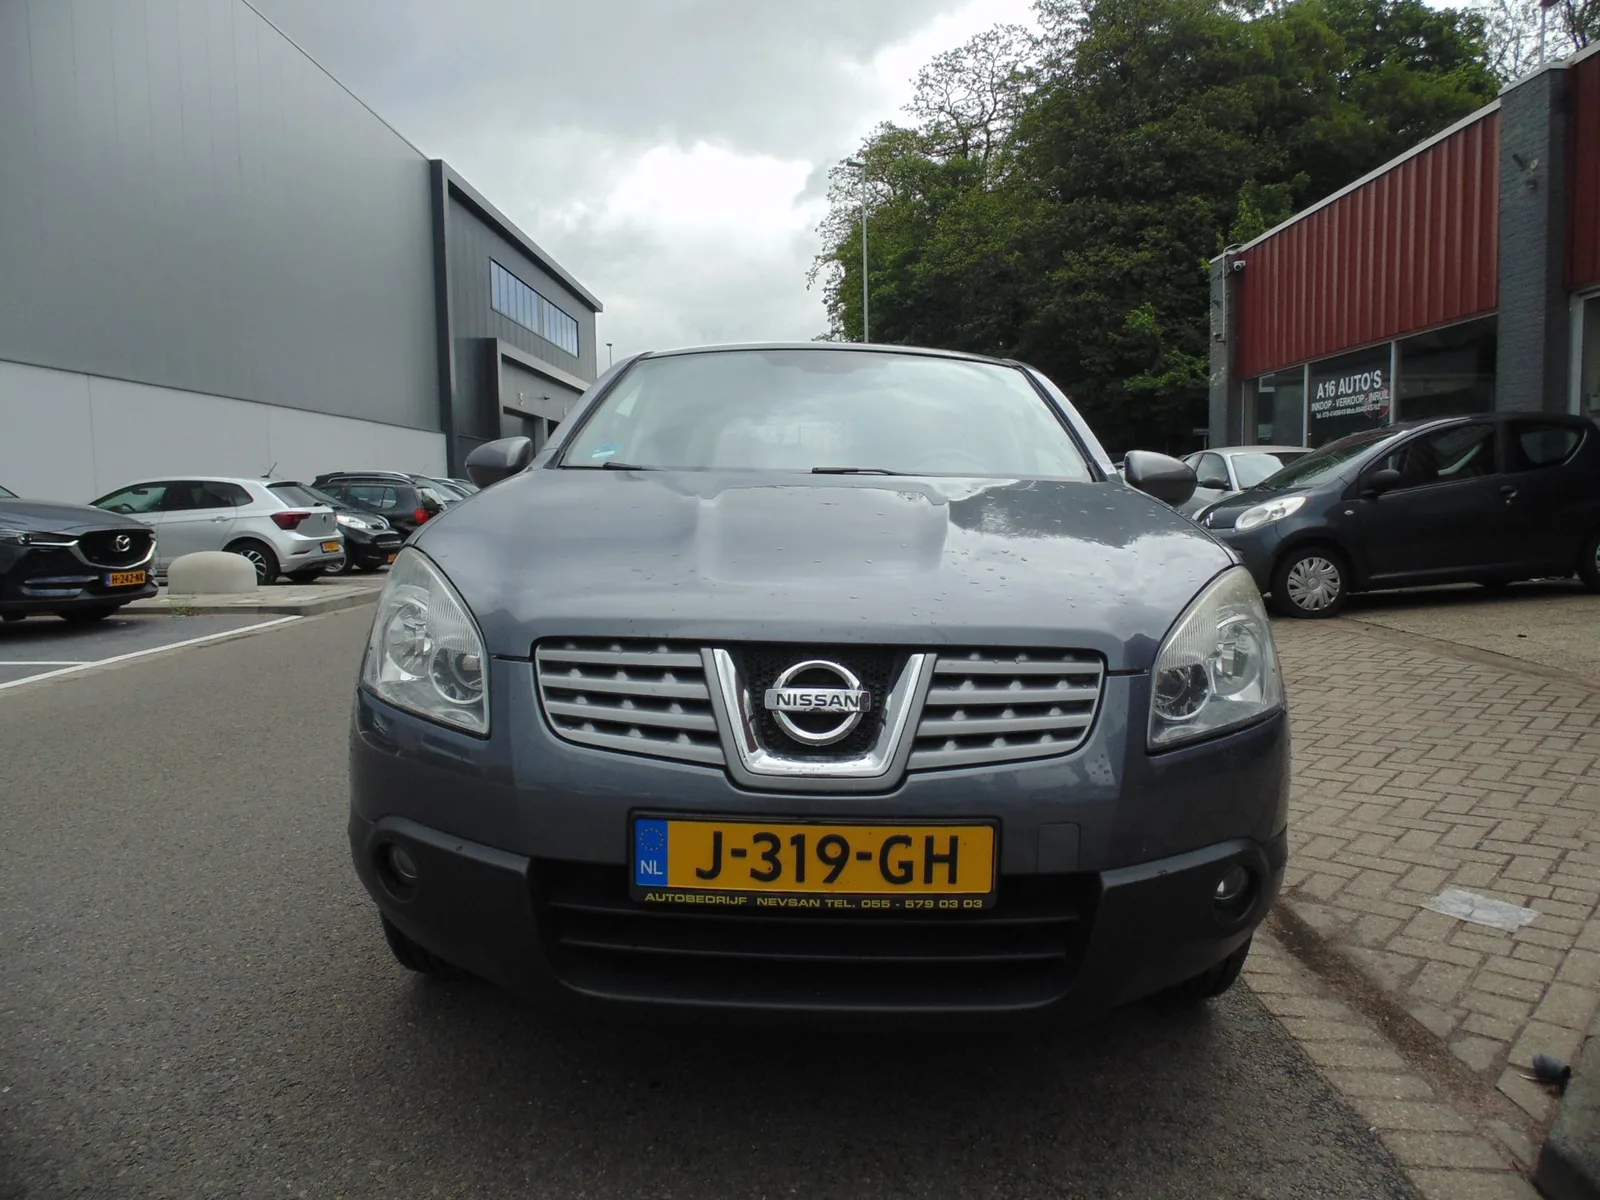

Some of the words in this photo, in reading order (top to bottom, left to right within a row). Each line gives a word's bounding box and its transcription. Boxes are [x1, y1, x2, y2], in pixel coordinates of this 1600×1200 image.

[1316, 380, 1336, 399] A16
[1338, 369, 1382, 395] AUTO'S
[1311, 400, 1332, 412] INKOOP
[1335, 394, 1365, 407] VERKOOP
[776, 693, 859, 707] NISSAN
[695, 830, 959, 885] J-319-GH
[640, 860, 663, 875] NL
[644, 892, 748, 905] AUTOBEDRIJF
[756, 897, 820, 908] NEVSAN
[824, 899, 856, 909] TEL.
[861, 899, 890, 909] 055
[905, 900, 934, 909] 579
[938, 900, 959, 909] 03
[963, 899, 983, 909] 03
